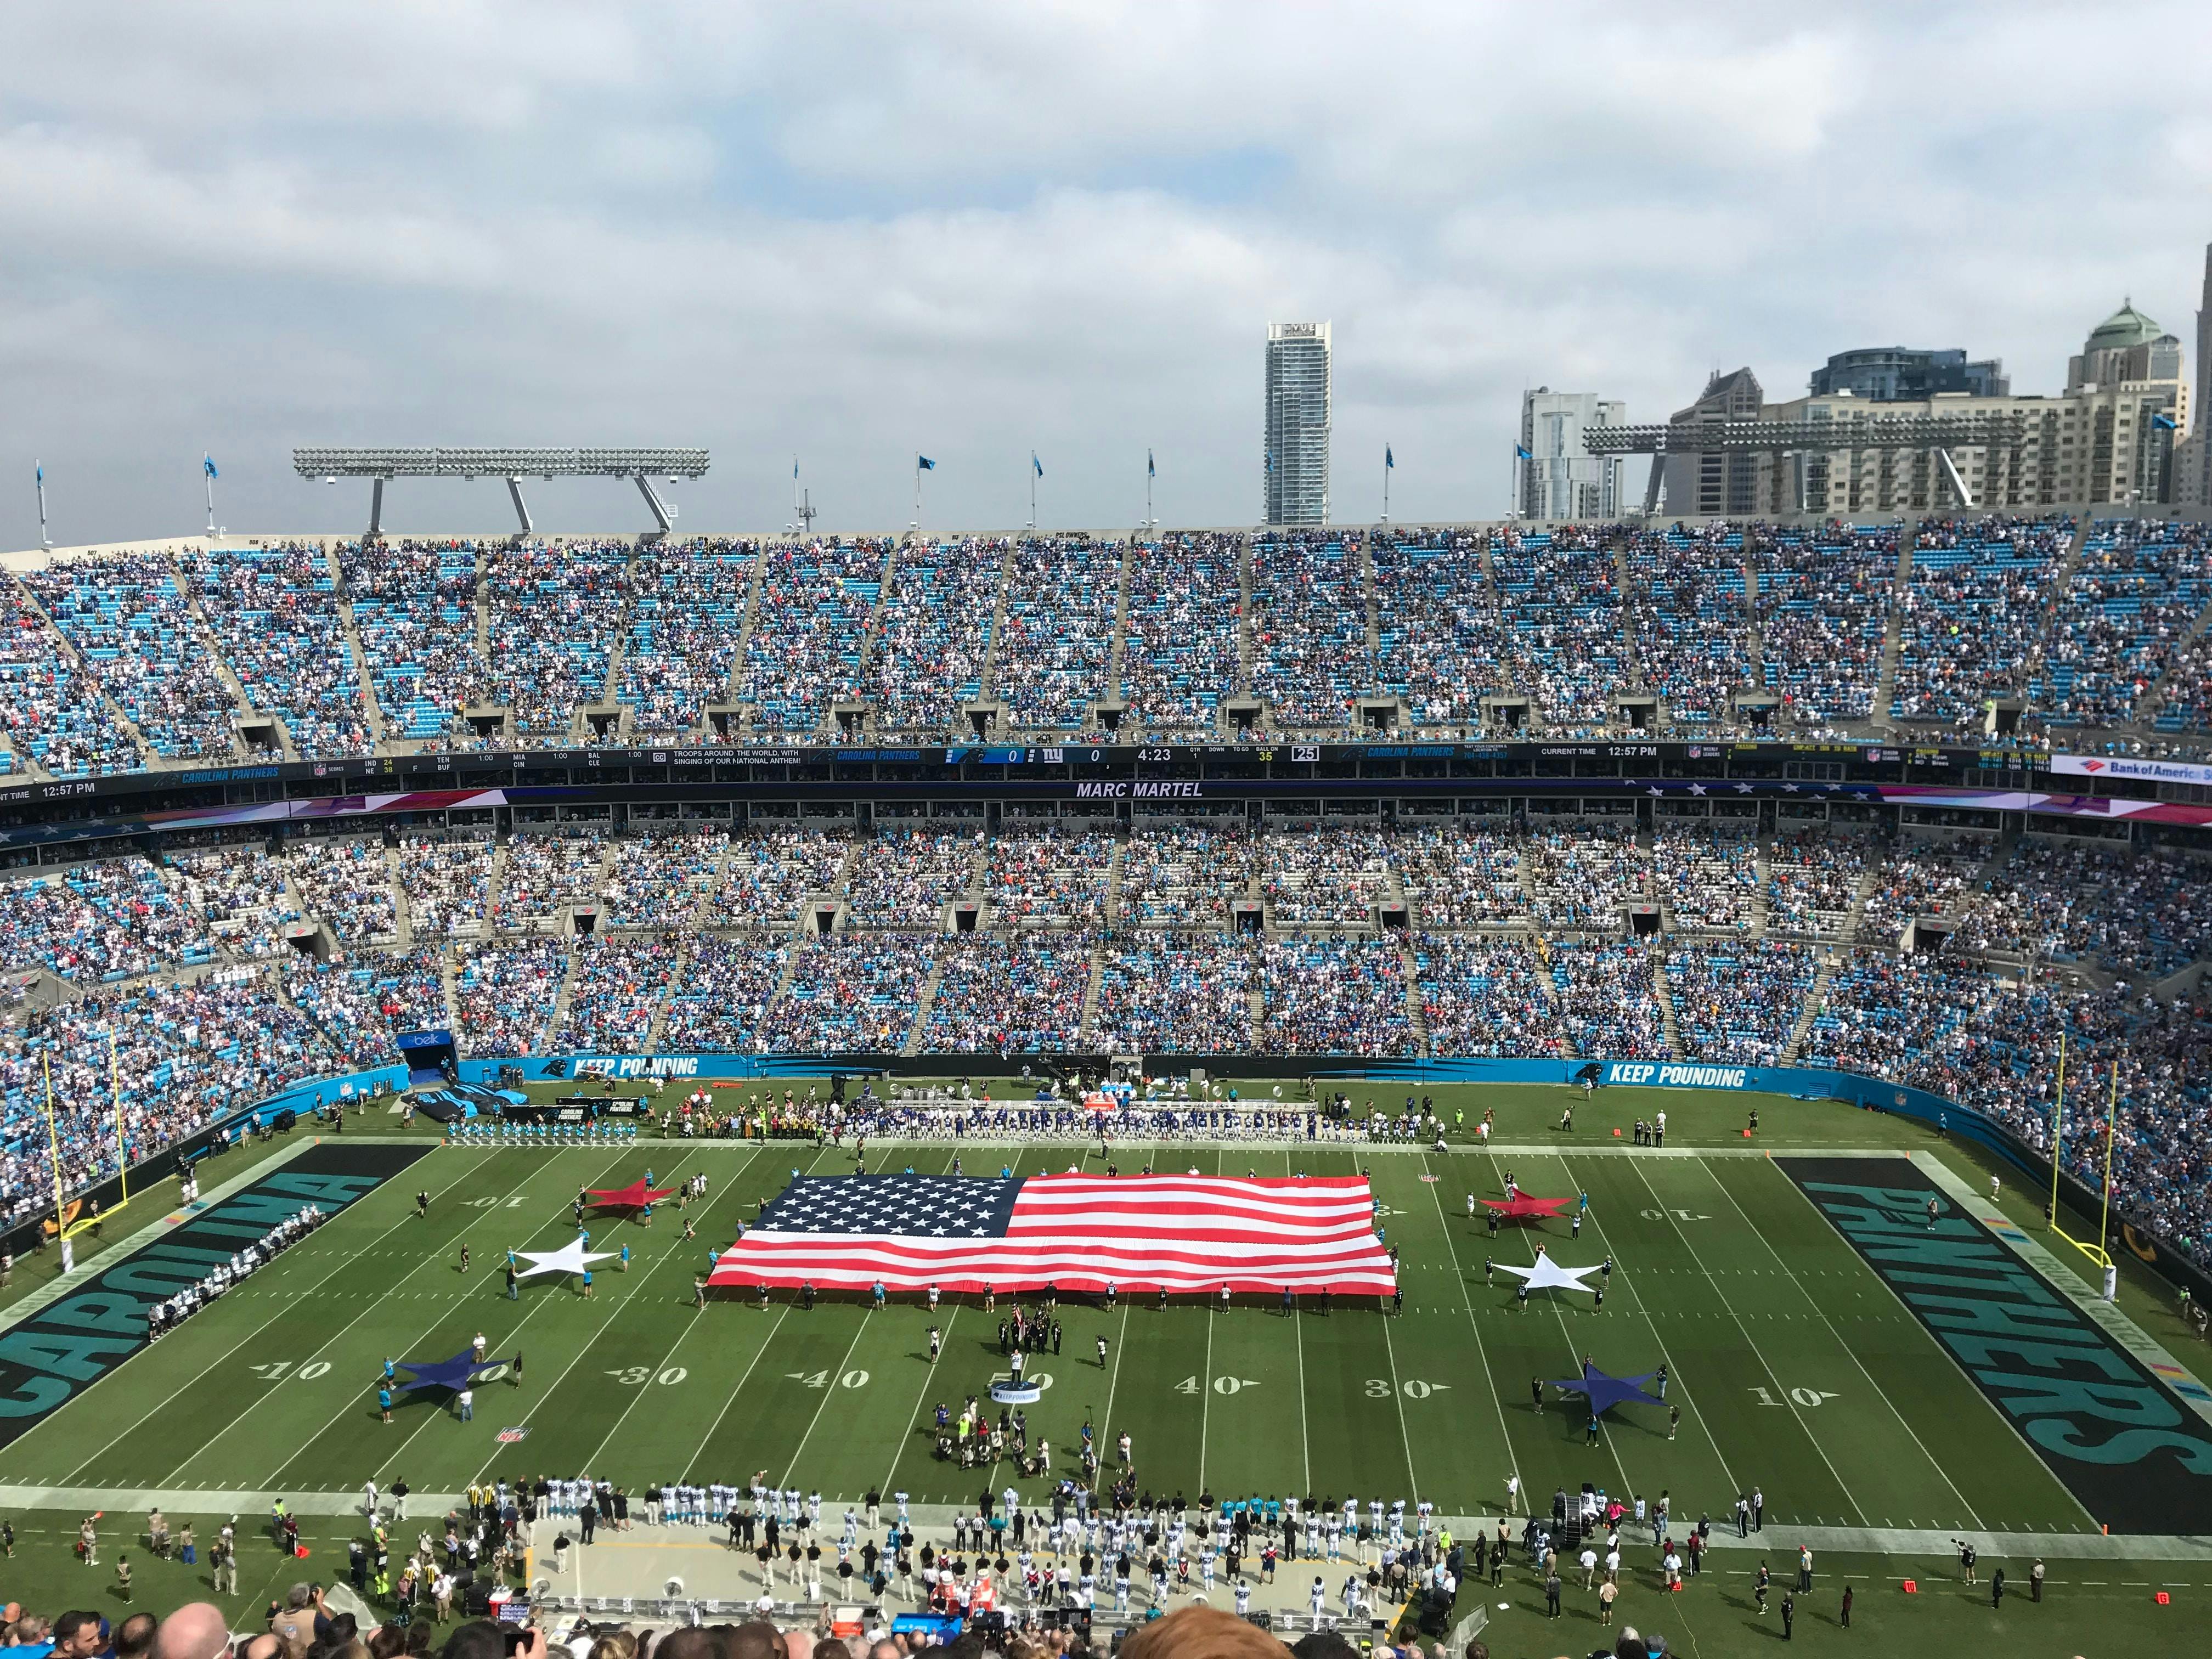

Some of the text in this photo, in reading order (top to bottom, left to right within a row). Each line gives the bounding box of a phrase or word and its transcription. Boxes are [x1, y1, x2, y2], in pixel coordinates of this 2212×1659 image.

[837, 750, 921, 760] CAROLINA PANTHERS
[1008, 749, 1017, 763] 0
[1091, 749, 1099, 762] 0
[1138, 748, 1171, 761] 4:23
[1259, 752, 1273, 761] 35
[1297, 748, 1314, 760] 25
[1368, 747, 1454, 758] CAROLINA PANTHERS
[1608, 747, 1657, 756] 12:57 PM
[2111, 761, 2138, 772] Bank
[2141, 765, 2153, 775] of
[182, 768, 279, 783] CAROLINA PANTHERS
[10, 791, 30, 799] TIME
[42, 782, 95, 797] 12:57 PM
[1076, 782, 1203, 797] MARC MARTEL
[414, 1034, 439, 1045] belk
[619, 1057, 698, 1076] POUNDING
[1610, 1064, 1746, 1087] KEEP POUNDING
[472, 1197, 530, 1208] 10
[1639, 1209, 1701, 1221] 10
[0, 1172, 383, 1418] CAROLINA
[1802, 1181, 2212, 1476] PANTHERS
[257, 1361, 332, 1381] 10
[618, 1366, 689, 1385] 30
[802, 1370, 870, 1389] 40
[1173, 1375, 1241, 1395] 40
[1364, 1379, 1431, 1399] 30
[1748, 1386, 1822, 1407] 10
[890, 1534, 894, 1543] 1
[1906, 1582, 1915, 1592] 10
[2160, 1594, 2166, 1603] G
